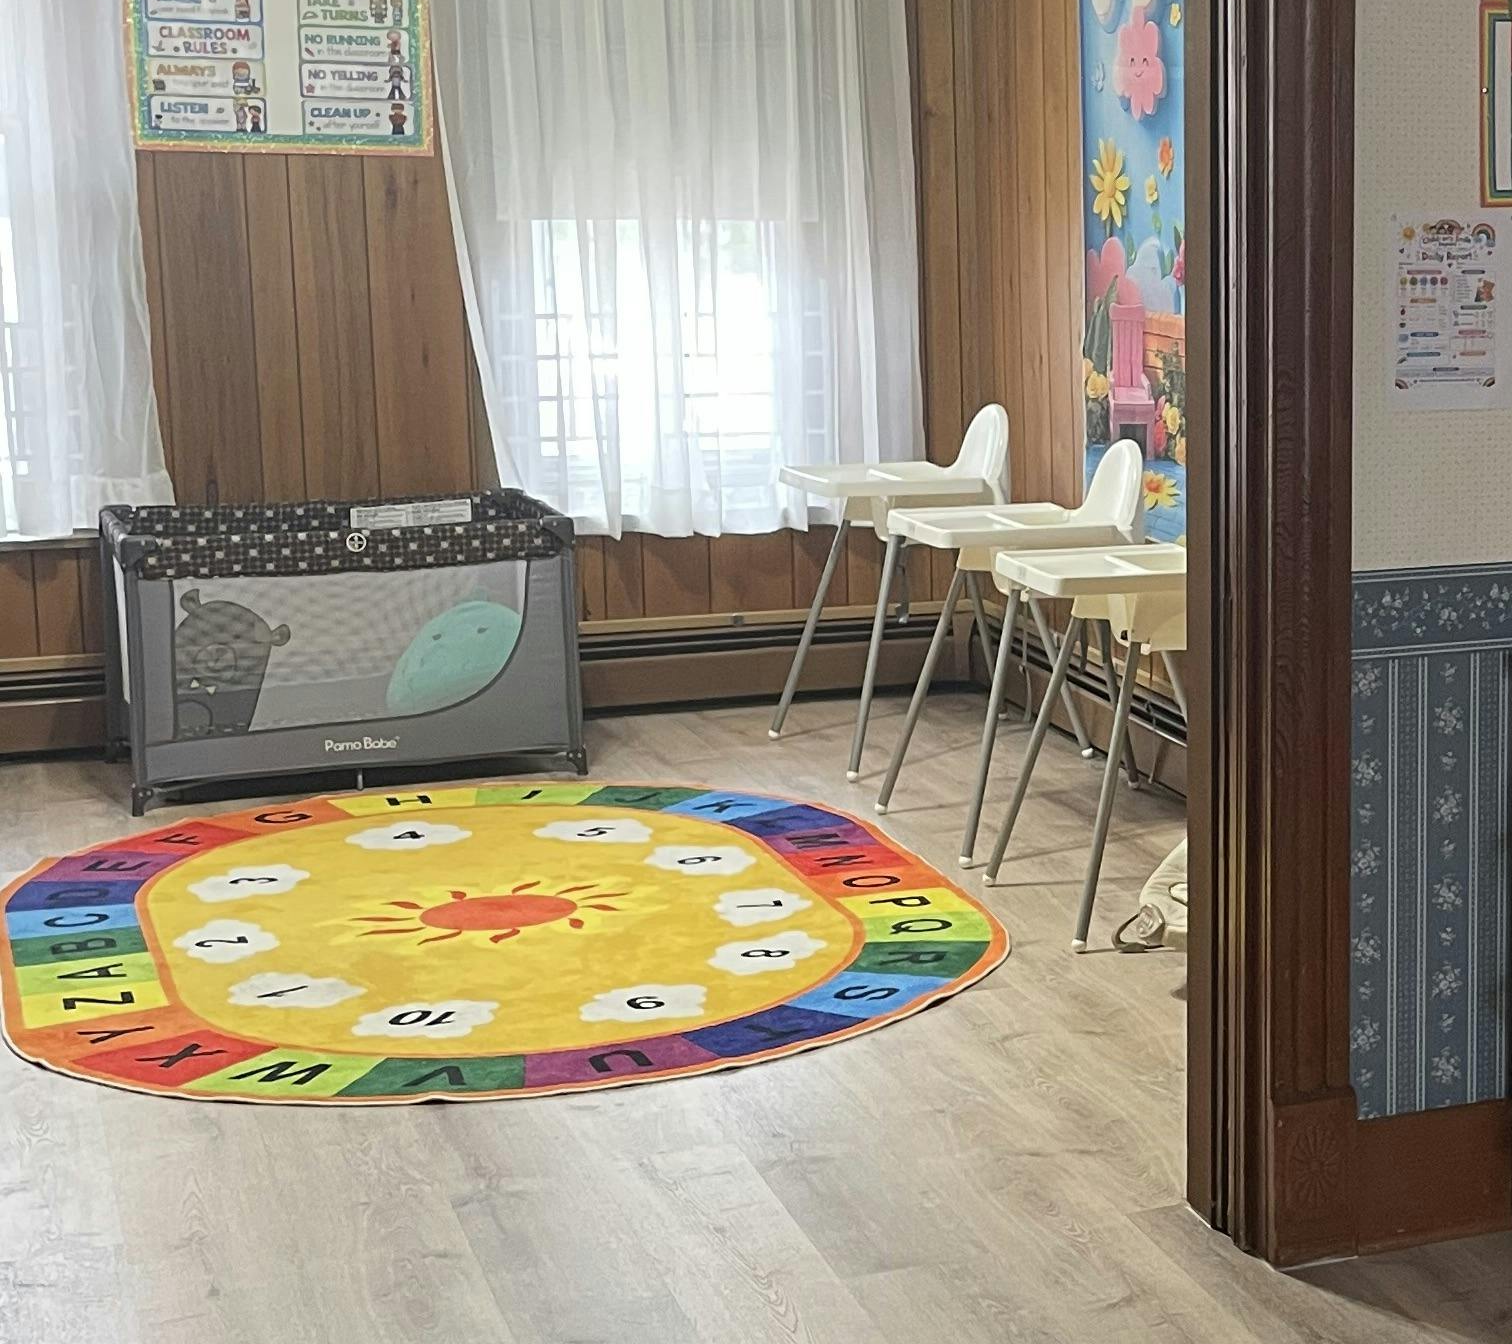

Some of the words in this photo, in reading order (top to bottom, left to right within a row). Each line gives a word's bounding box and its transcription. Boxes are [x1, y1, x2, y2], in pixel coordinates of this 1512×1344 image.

[321, 9, 369, 22] TURNS
[159, 26, 250, 41] CLASSROOM
[304, 34, 323, 45] NO
[326, 35, 381, 46] RUNNING
[182, 41, 228, 54] RULES
[308, 69, 327, 80] NO
[330, 70, 379, 82] YELLING
[160, 102, 209, 114] LISTEN
[310, 107, 352, 119] CLEAN
[353, 108, 371, 118] UP
[324, 739, 362, 752] Pamo
[386, 794, 432, 807] H
[692, 799, 752, 814] K
[254, 810, 313, 824] G
[154, 833, 202, 846] F
[393, 830, 425, 840] 4
[577, 826, 616, 839] 5
[785, 832, 850, 849] M
[82, 859, 151, 873] E
[677, 855, 723, 866] 6
[815, 854, 873, 868] N
[229, 876, 279, 886] 3
[842, 875, 901, 888] O
[736, 899, 783, 909] 7
[868, 895, 931, 908] P
[43, 913, 110, 929] C
[888, 918, 953, 936] Q
[51, 937, 117, 955] B
[195, 936, 249, 949] 2
[740, 948, 790, 959] 8
[887, 951, 946, 967] R
[57, 962, 127, 980] A
[257, 985, 308, 998] 1
[833, 984, 900, 1002] S
[64, 991, 134, 1011] Z
[626, 995, 665, 1010] 9
[389, 1010, 456, 1026] 10
[77, 1025, 155, 1044] Y
[745, 1023, 804, 1043] T
[135, 1043, 228, 1068] X
[588, 1049, 653, 1072] U
[229, 1060, 333, 1086] W
[402, 1065, 467, 1087] V
